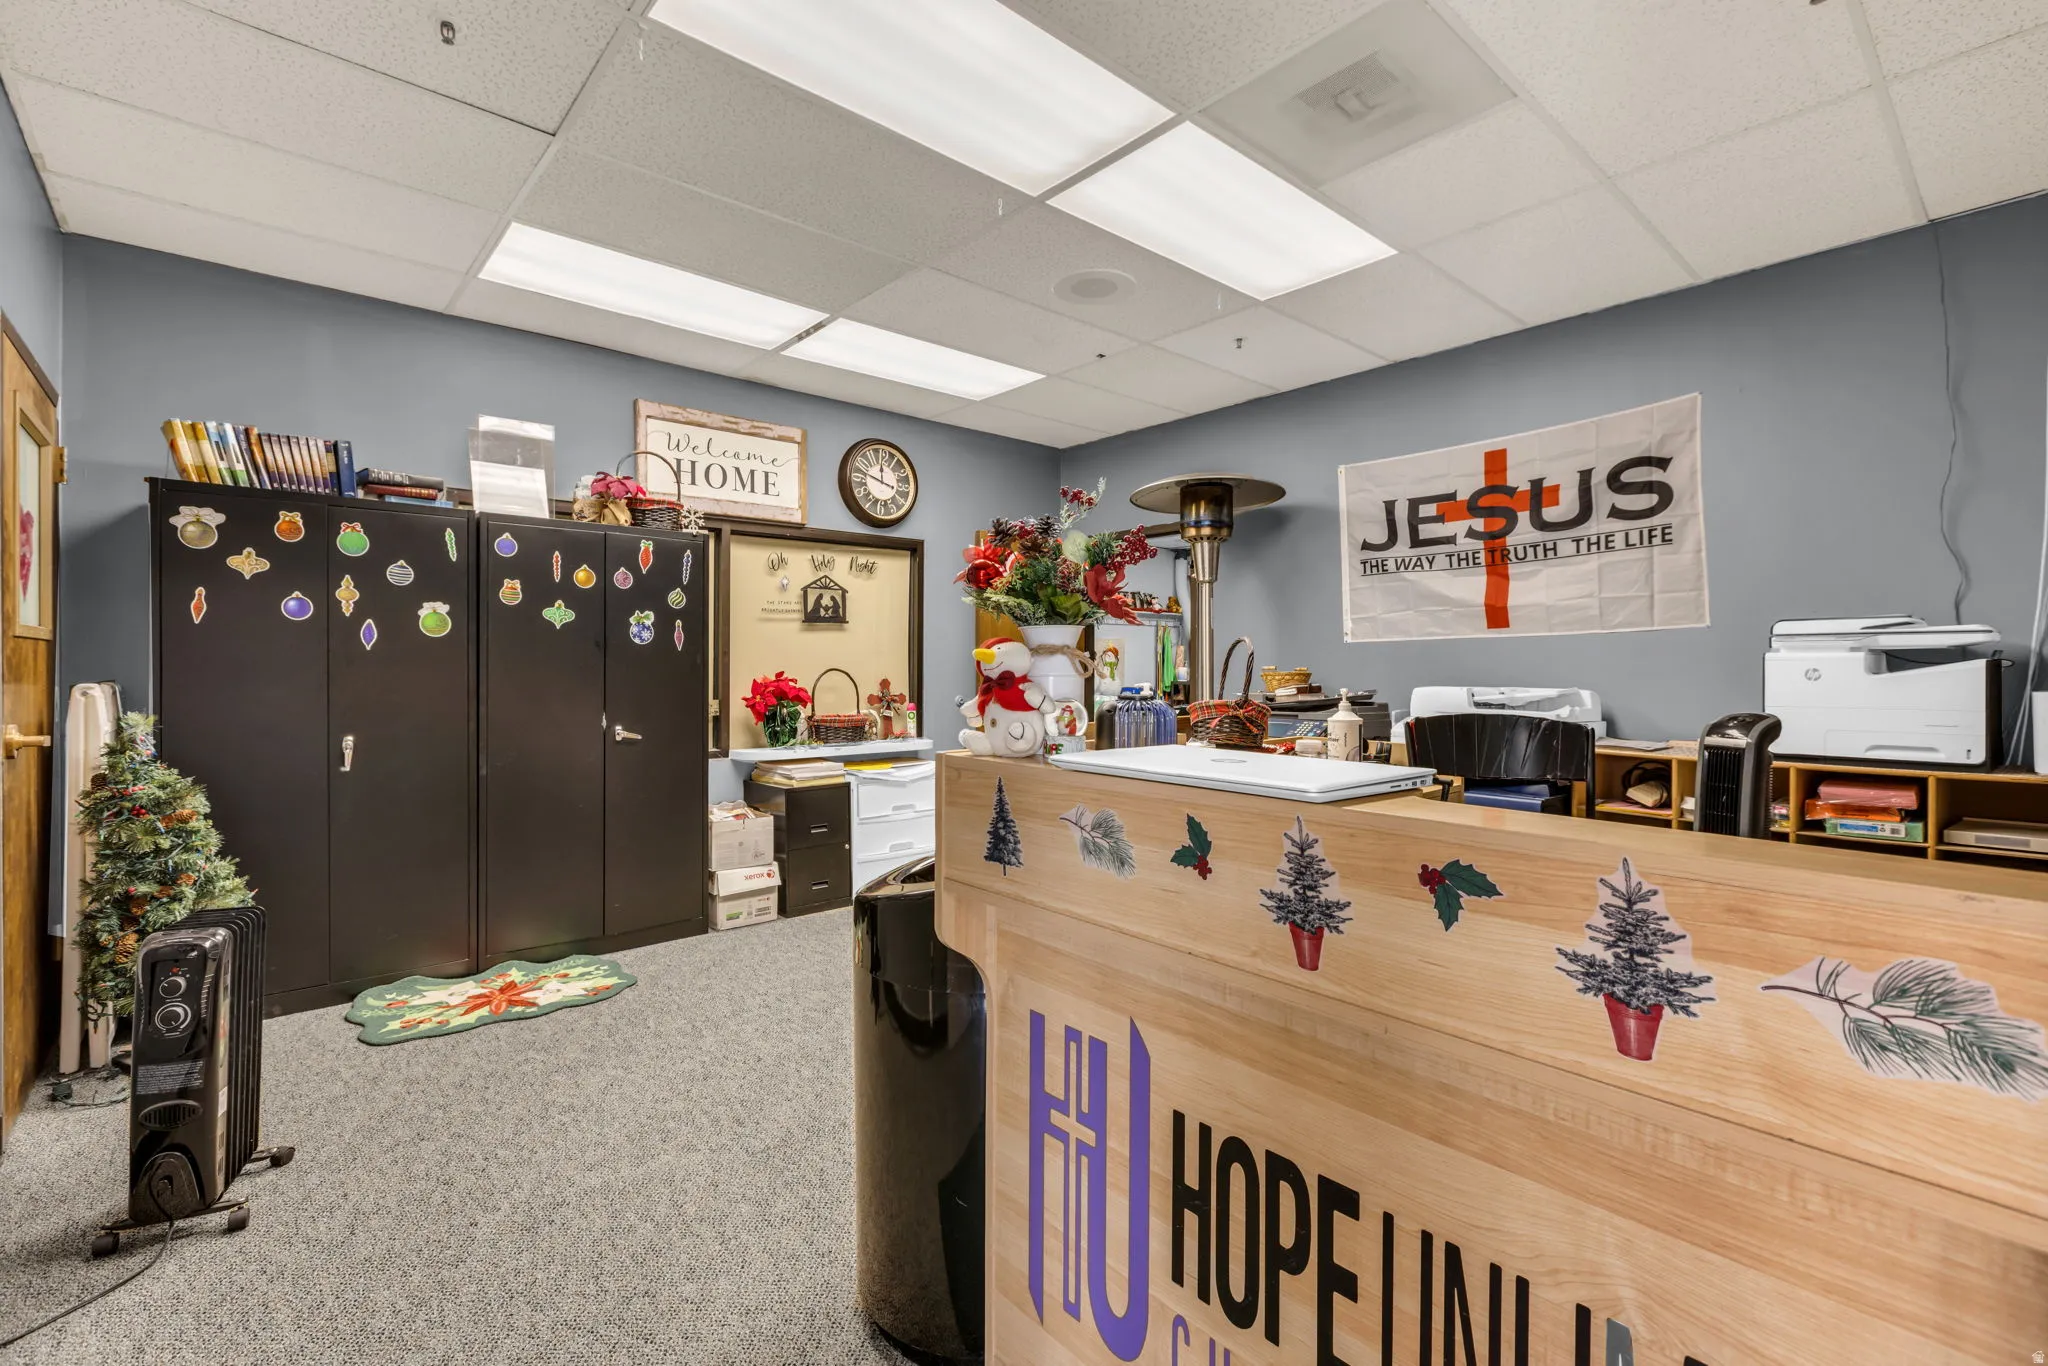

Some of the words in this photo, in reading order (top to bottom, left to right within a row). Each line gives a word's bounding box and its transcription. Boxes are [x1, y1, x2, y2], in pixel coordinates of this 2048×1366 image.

[666, 431, 799, 468] Welcome
[866, 449, 877, 466] 11
[879, 449, 889, 466] 12
[855, 457, 871, 473] 10
[673, 457, 780, 497] HOME
[852, 473, 867, 482] 9
[894, 469, 908, 479] 2
[855, 486, 869, 497] 8
[896, 482, 910, 492] 3
[876, 500, 885, 516] 6
[886, 499, 897, 514] 5
[1360, 455, 1674, 552] JESUS
[1361, 559, 1389, 575] THE
[1394, 555, 1436, 572] WAY
[1445, 549, 1482, 568] THE
[1487, 541, 1558, 565] TRUTH
[1571, 533, 1616, 555] THE
[1624, 525, 1674, 548] LIFE
[767, 552, 789, 571] Oh
[744, 872, 765, 881] xerox
[1171, 1109, 1360, 1366] HOPE
